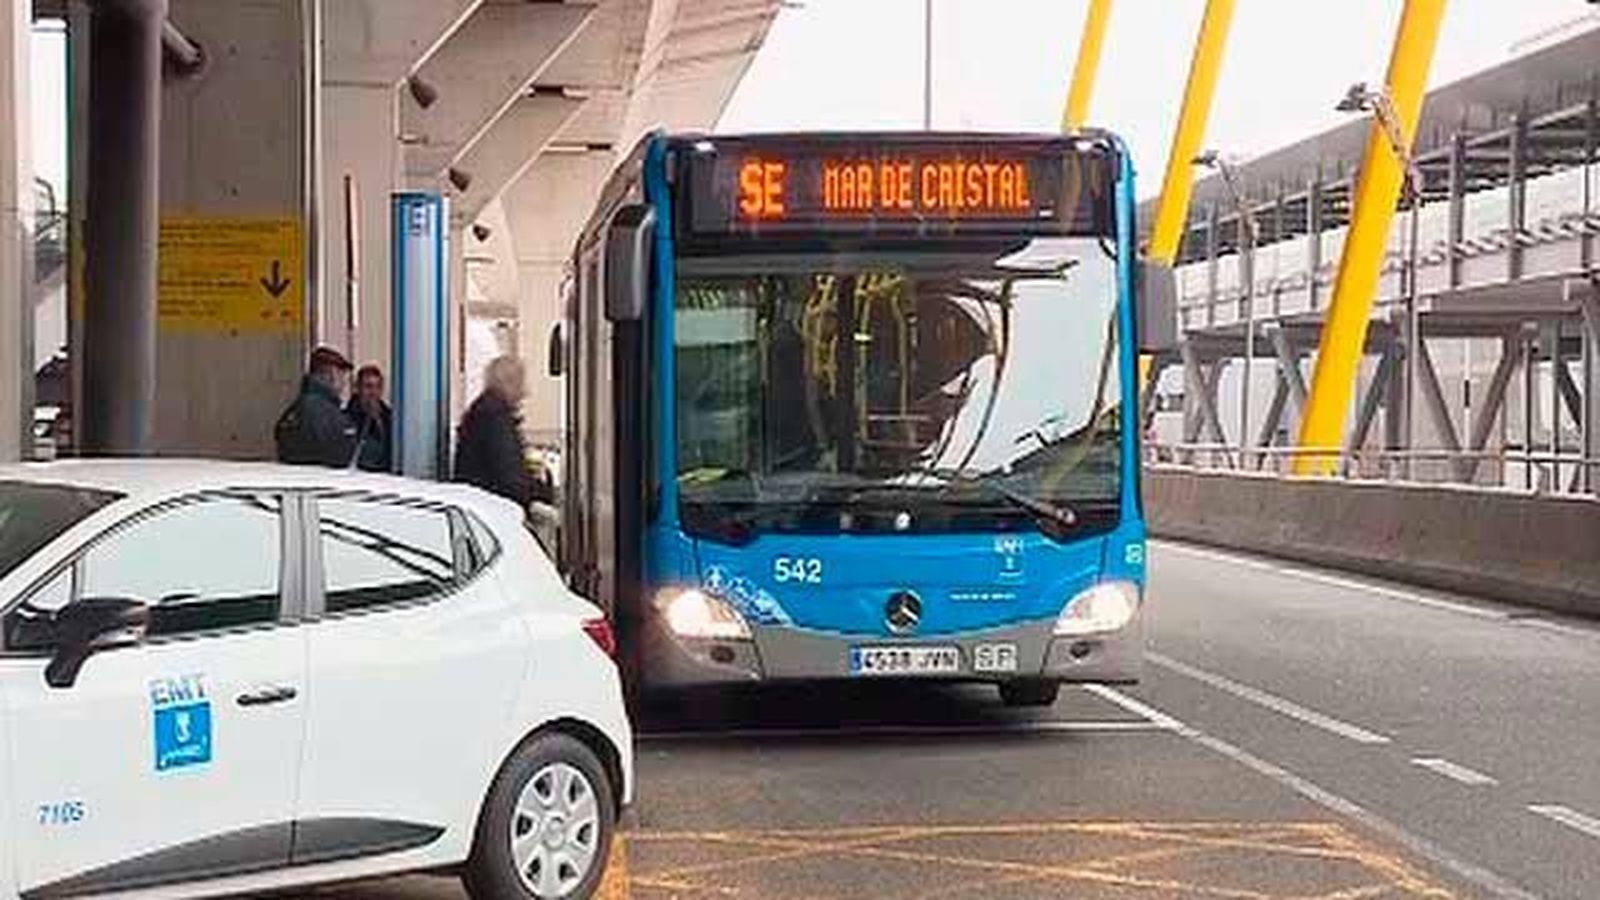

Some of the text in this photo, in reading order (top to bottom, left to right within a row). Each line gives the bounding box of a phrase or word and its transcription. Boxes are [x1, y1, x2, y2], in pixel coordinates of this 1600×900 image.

[824, 163, 1031, 209] MAR DE CRISTAL
[774, 557, 822, 583] 542
[149, 673, 207, 704] EMT
